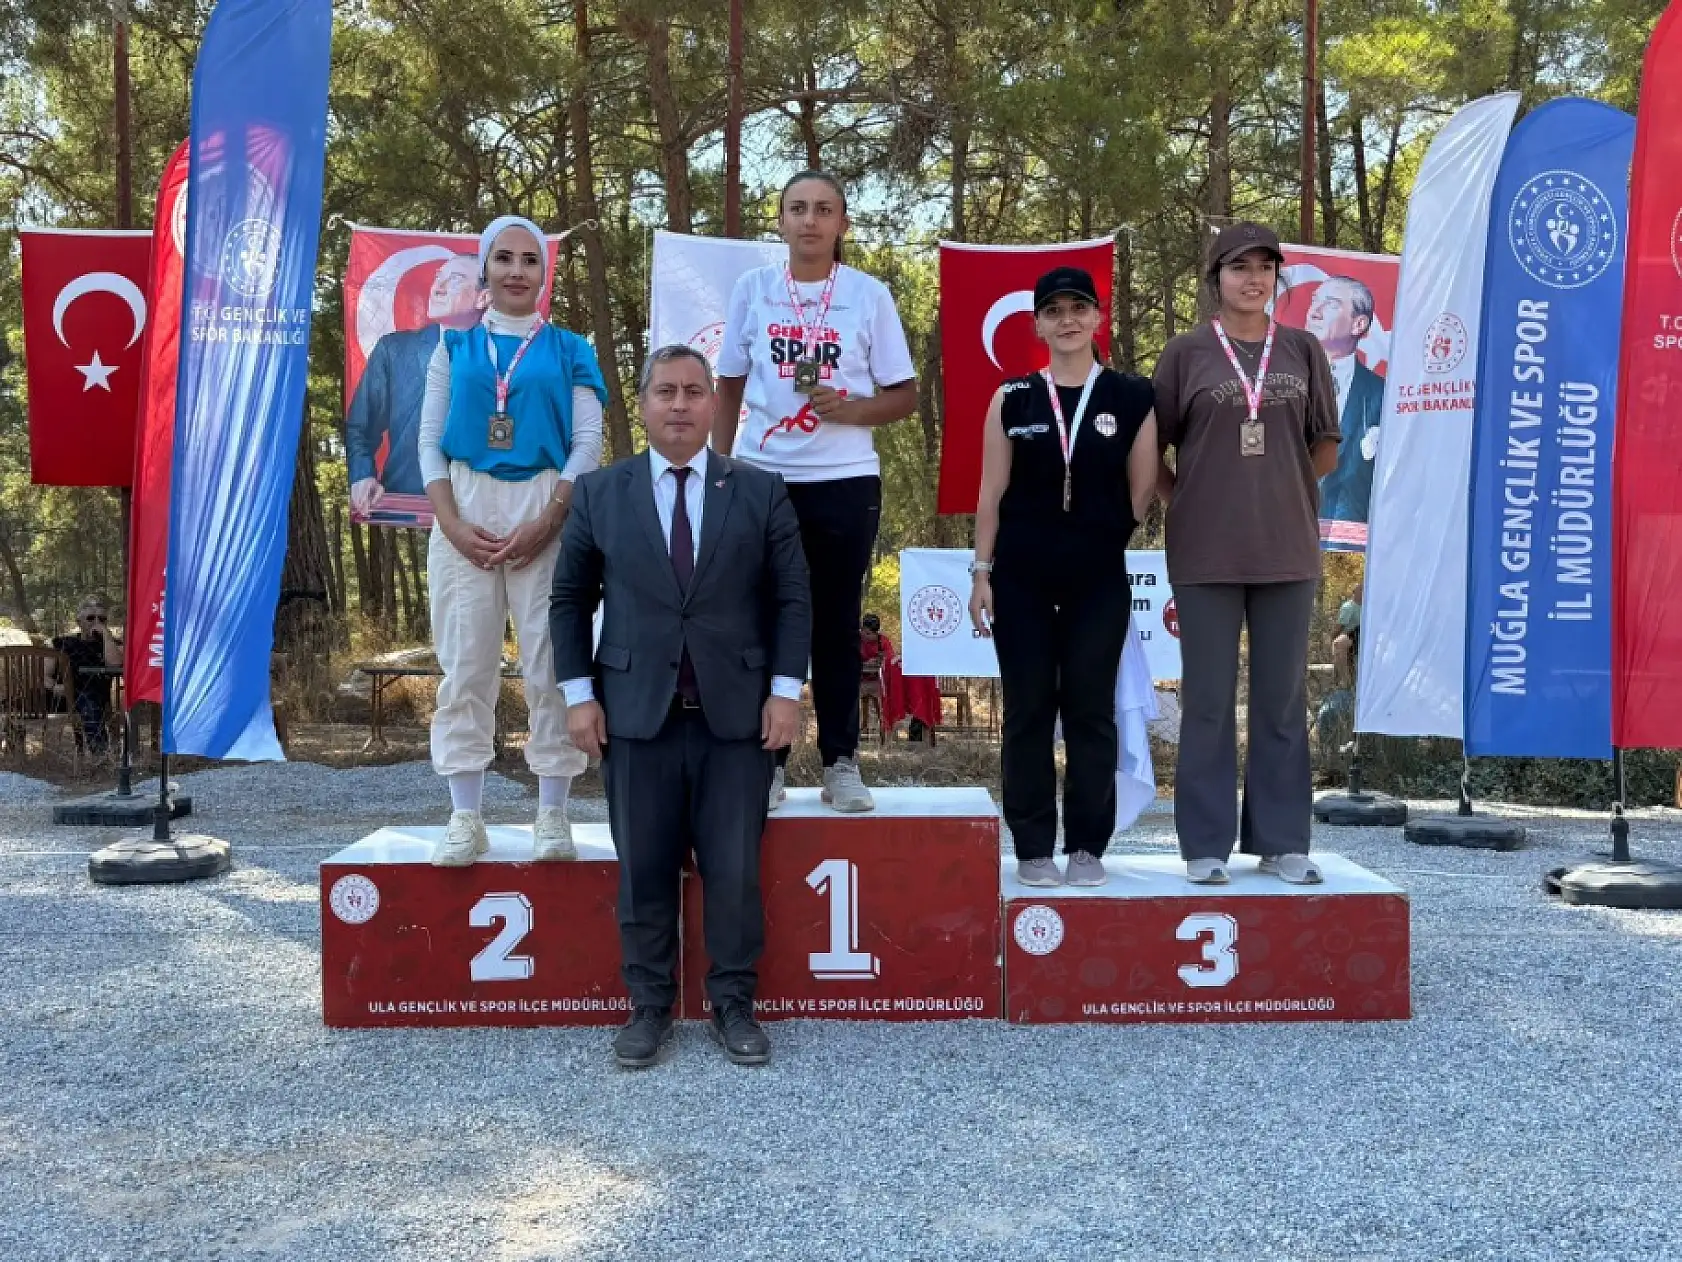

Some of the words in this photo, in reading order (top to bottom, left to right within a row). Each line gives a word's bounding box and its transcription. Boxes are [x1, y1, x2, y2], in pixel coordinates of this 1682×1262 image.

[1513, 299, 1549, 384] SPOR
[1509, 389, 1543, 429] VE
[1500, 434, 1541, 572] GENÇLİK
[1550, 381, 1600, 585] MÜDÜRLÜĞÜ
[1490, 581, 1530, 695] MUĞLA
[1548, 592, 1593, 621] İL
[469, 891, 534, 982] 2
[805, 858, 881, 980] 1
[1175, 912, 1240, 988] 3
[368, 1000, 396, 1013] ULA
[399, 999, 457, 1014] GENÇLİK
[460, 1000, 478, 1013] VE
[480, 1000, 516, 1013] SPOR
[519, 998, 549, 1014] İLÇE
[753, 997, 795, 1014] NÇLİK
[798, 999, 816, 1011] VE
[818, 999, 856, 1011] SPOR
[860, 996, 891, 1013] İLÇE
[894, 996, 983, 1011] MÜDÜRLÜĞÜ
[1083, 1003, 1108, 1015] ULA
[1111, 1000, 1166, 1015] GENÇLİK
[1168, 1002, 1185, 1013] VE
[1187, 1001, 1221, 1013] SPOR
[1224, 999, 1252, 1014] İLÇE
[1255, 996, 1335, 1012] MÜDÜRLÜĞÜ
